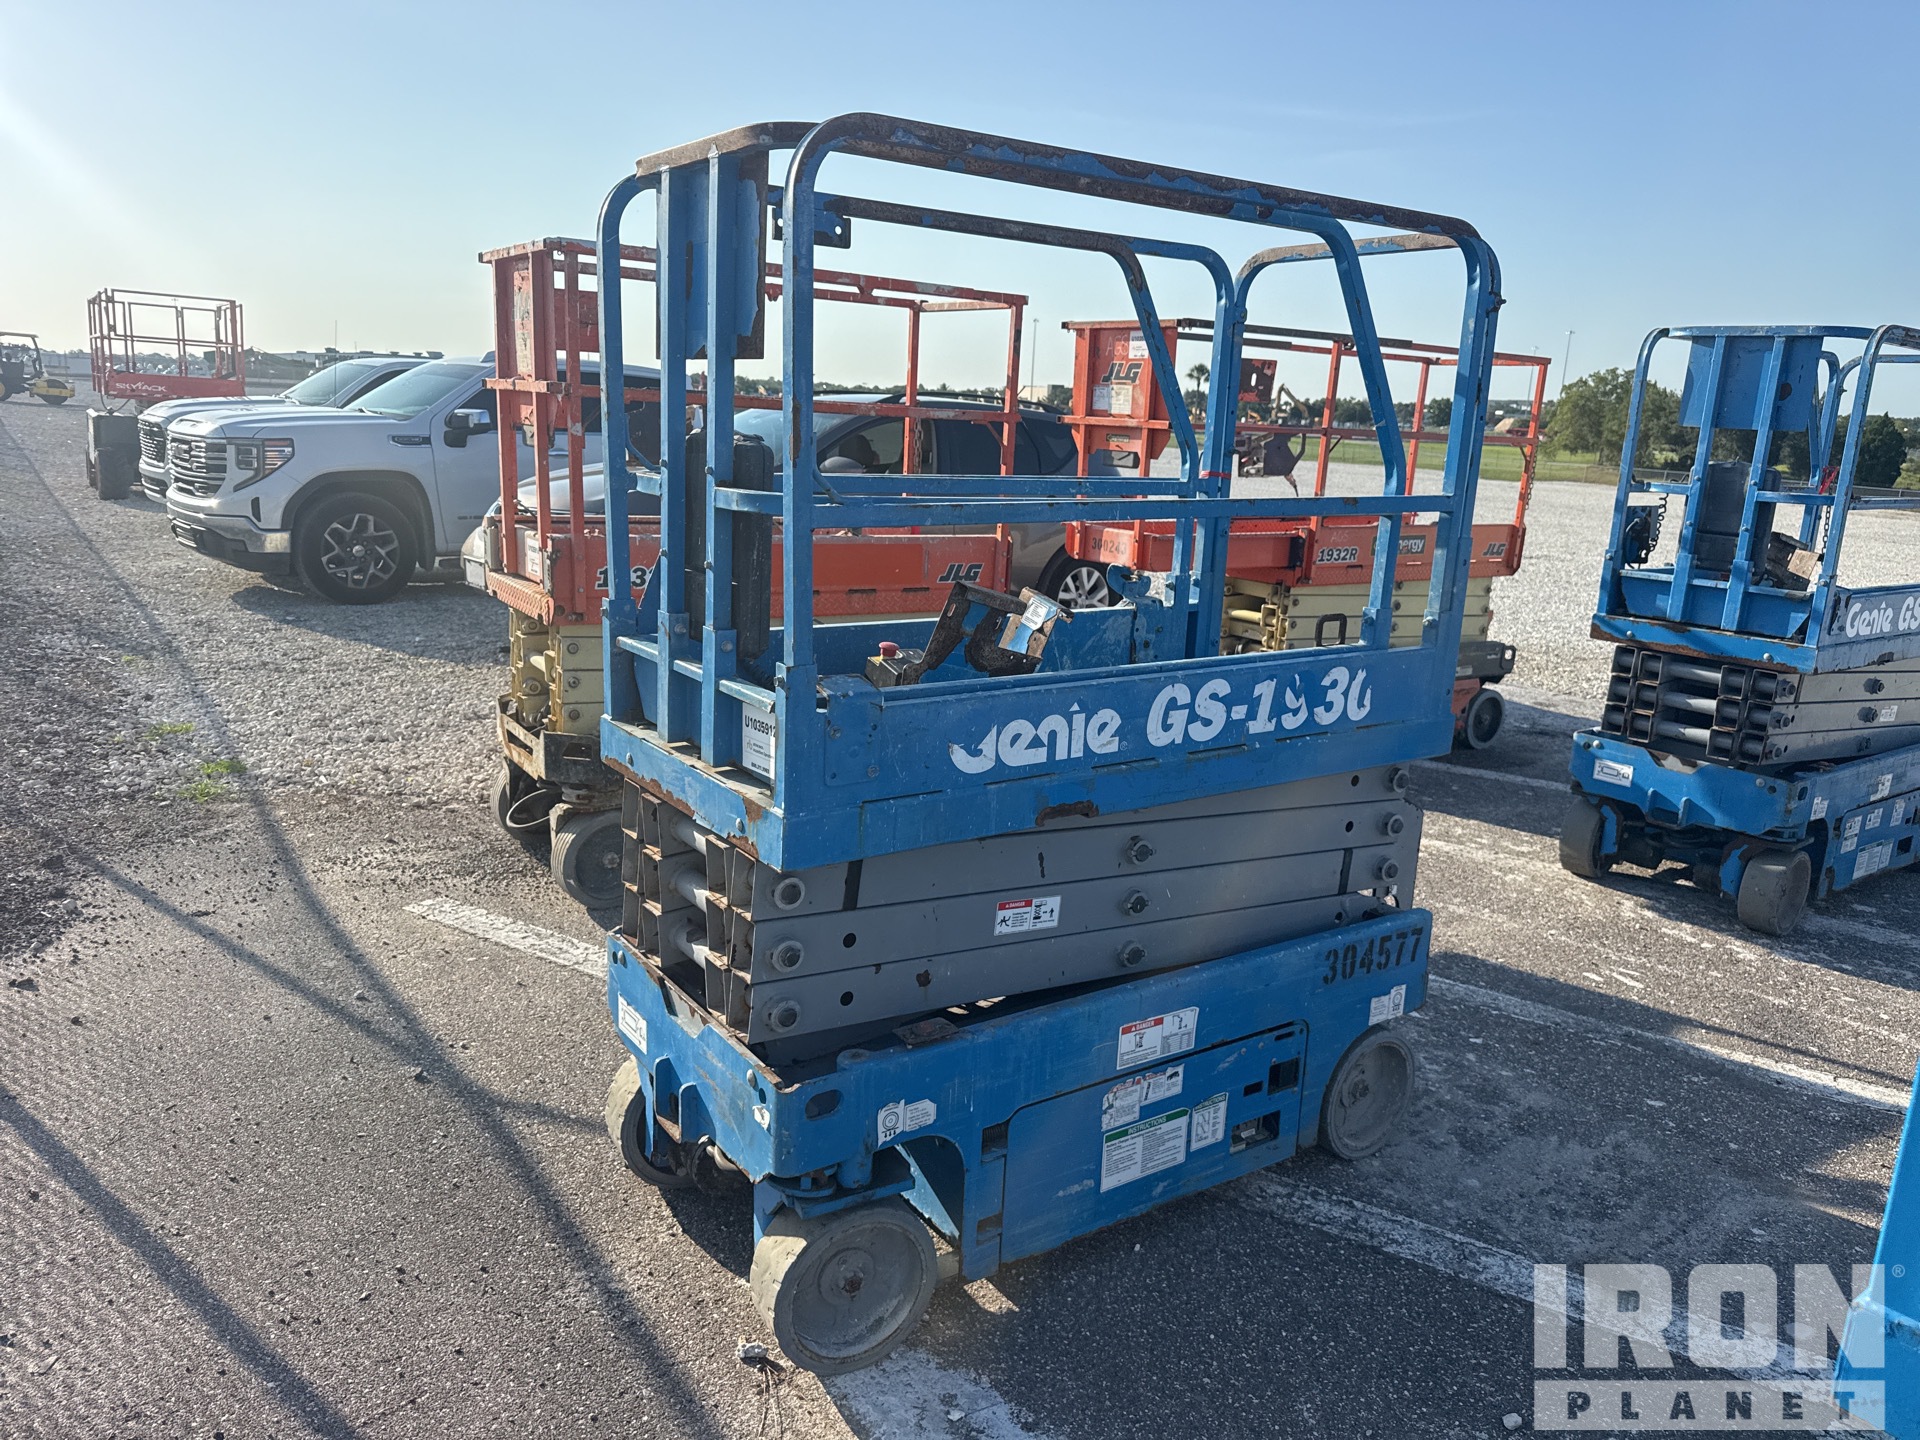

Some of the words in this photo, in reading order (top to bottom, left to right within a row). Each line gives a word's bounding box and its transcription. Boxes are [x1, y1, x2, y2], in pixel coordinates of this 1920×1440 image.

[1101, 361, 1143, 384] JLG
[1092, 537, 1127, 555] 300243
[1316, 546, 1359, 565] 1932R
[1482, 543, 1507, 557] JLG
[937, 563, 984, 583] JLG
[1846, 601, 1893, 638] Genie
[1322, 927, 1423, 985] 304577
[1136, 1020, 1155, 1030] DANGER
[1127, 1115, 1167, 1135] INSTRUCTIONS
